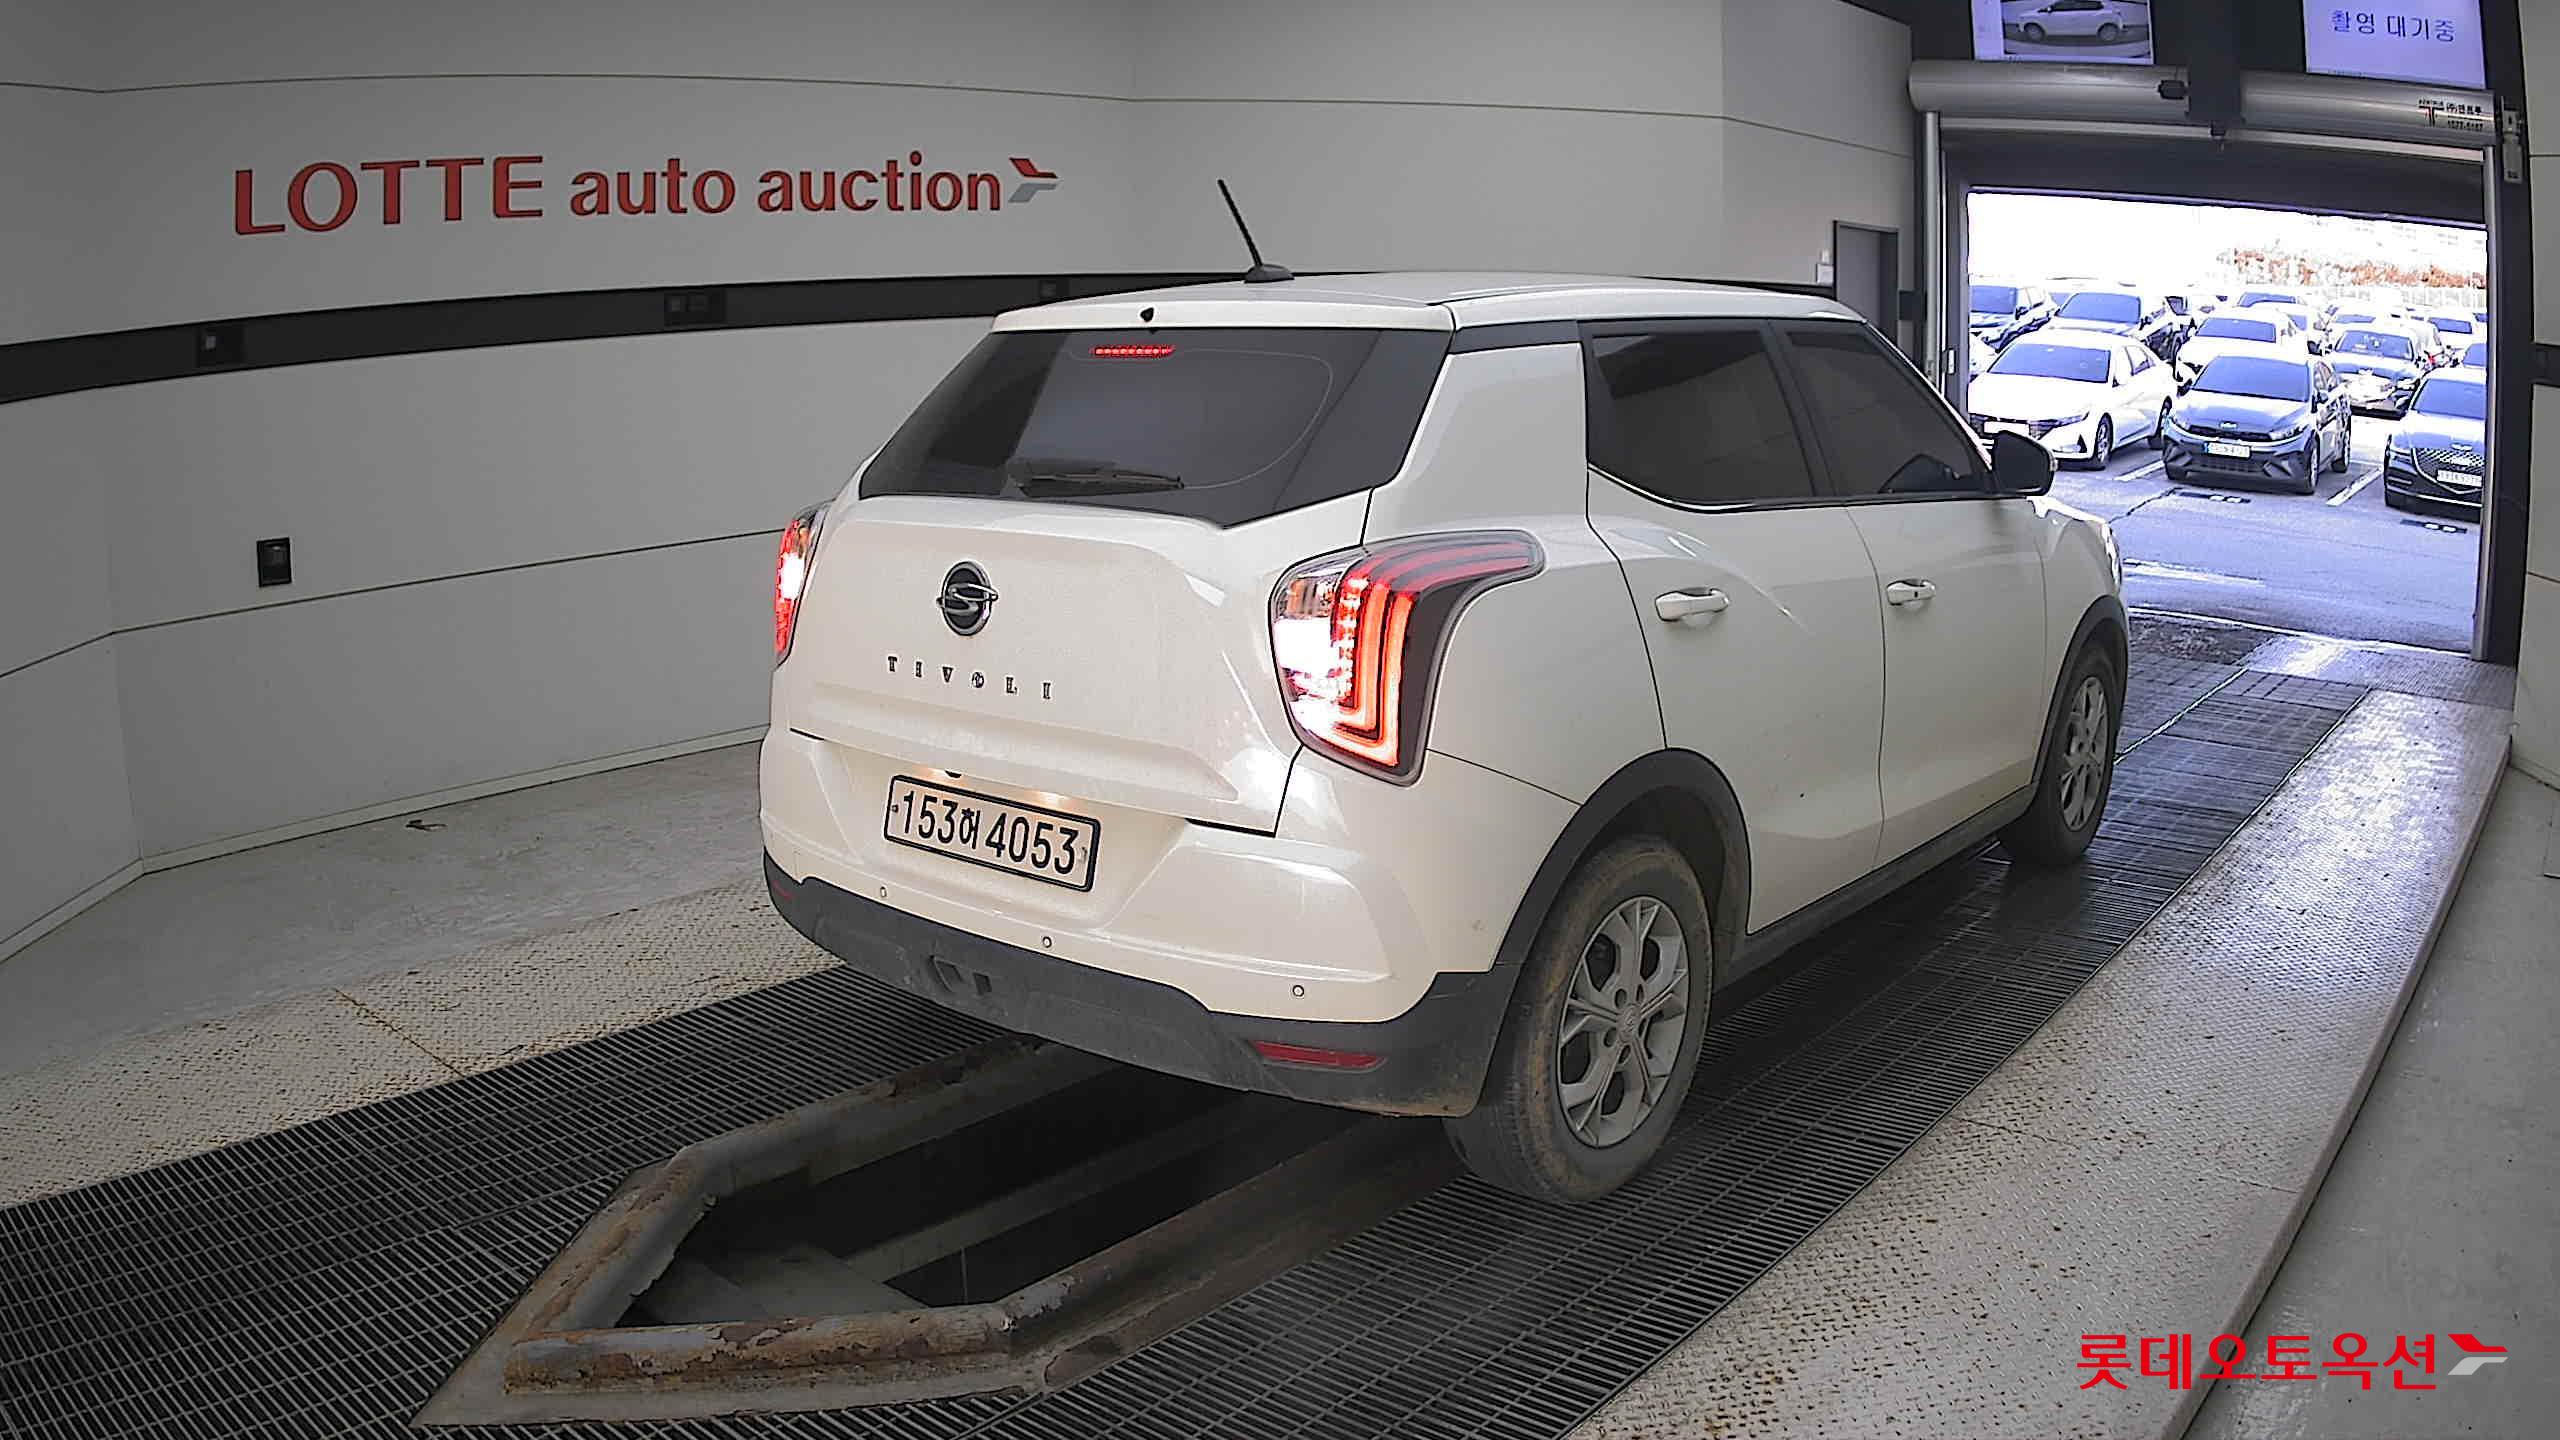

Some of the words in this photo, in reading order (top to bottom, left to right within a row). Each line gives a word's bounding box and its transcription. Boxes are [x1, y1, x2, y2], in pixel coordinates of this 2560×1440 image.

[2331, 9, 2375, 35] 촬영
[2387, 14, 2456, 43] 대기중
[234, 156, 543, 235] LOTTE
[570, 158, 735, 215] auto
[757, 151, 1002, 213] auction
[887, 655, 1052, 700] TIVOLI
